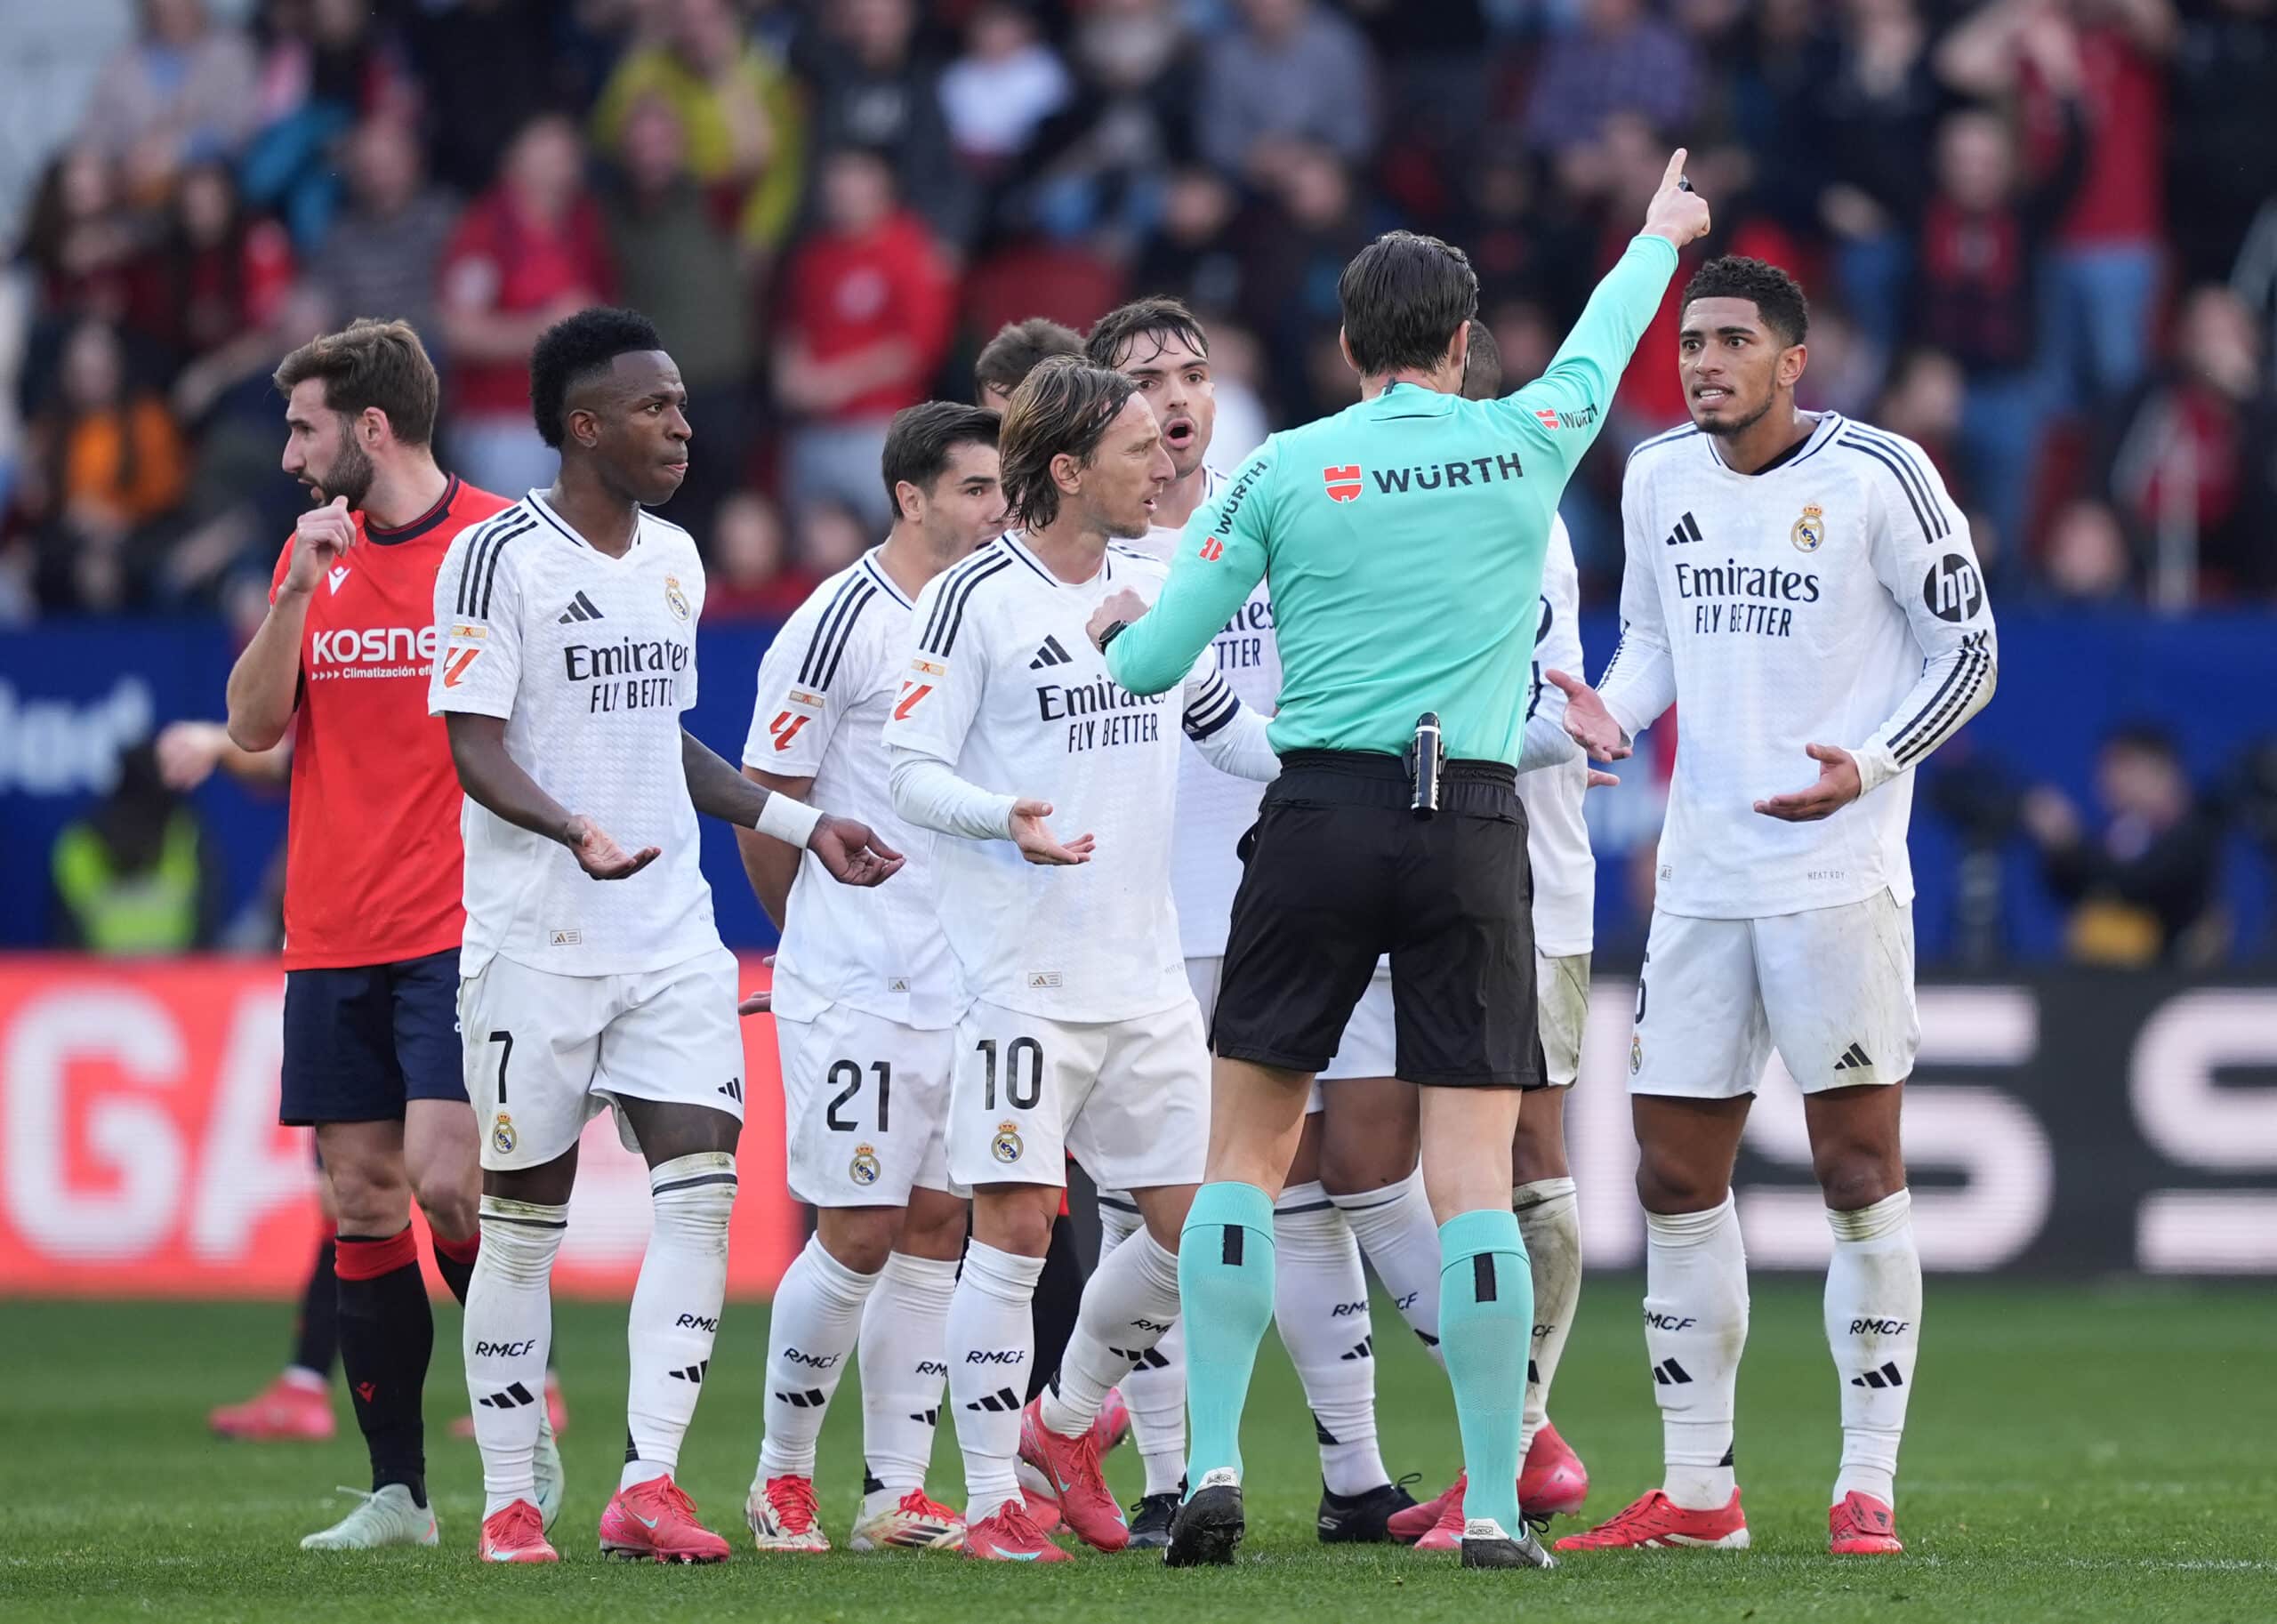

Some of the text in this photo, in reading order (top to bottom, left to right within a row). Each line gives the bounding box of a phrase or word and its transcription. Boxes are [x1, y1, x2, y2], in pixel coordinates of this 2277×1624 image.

[1558, 403, 1598, 428] WÜRT
[1372, 452, 1524, 494] WÜRTH
[1214, 461, 1267, 535] WÜRTH
[1675, 558, 1820, 603] Emirates
[1931, 554, 1978, 623] hp
[1695, 603, 1792, 637] FLY BETTER
[564, 636, 689, 681] Emirates
[1211, 638, 1261, 671] TTER
[342, 665, 415, 679] Climatización
[591, 678, 672, 713] FLY BETT
[1068, 712, 1159, 753] FLY BETTER
[489, 1031, 513, 1104] 7
[976, 1036, 1043, 1111] 10
[827, 1059, 891, 1132] 21
[1332, 1300, 1370, 1316] RMC
[1394, 1291, 1418, 1310] CF
[676, 1314, 719, 1332] RMC
[1130, 1319, 1172, 1333] RM
[1532, 1324, 1557, 1338] CF
[1849, 1318, 1910, 1335] RMCF
[475, 1339, 535, 1357] RMCF
[784, 1347, 841, 1369] RMCF
[966, 1350, 1026, 1363] RMCF
[915, 1361, 947, 1377] RM
